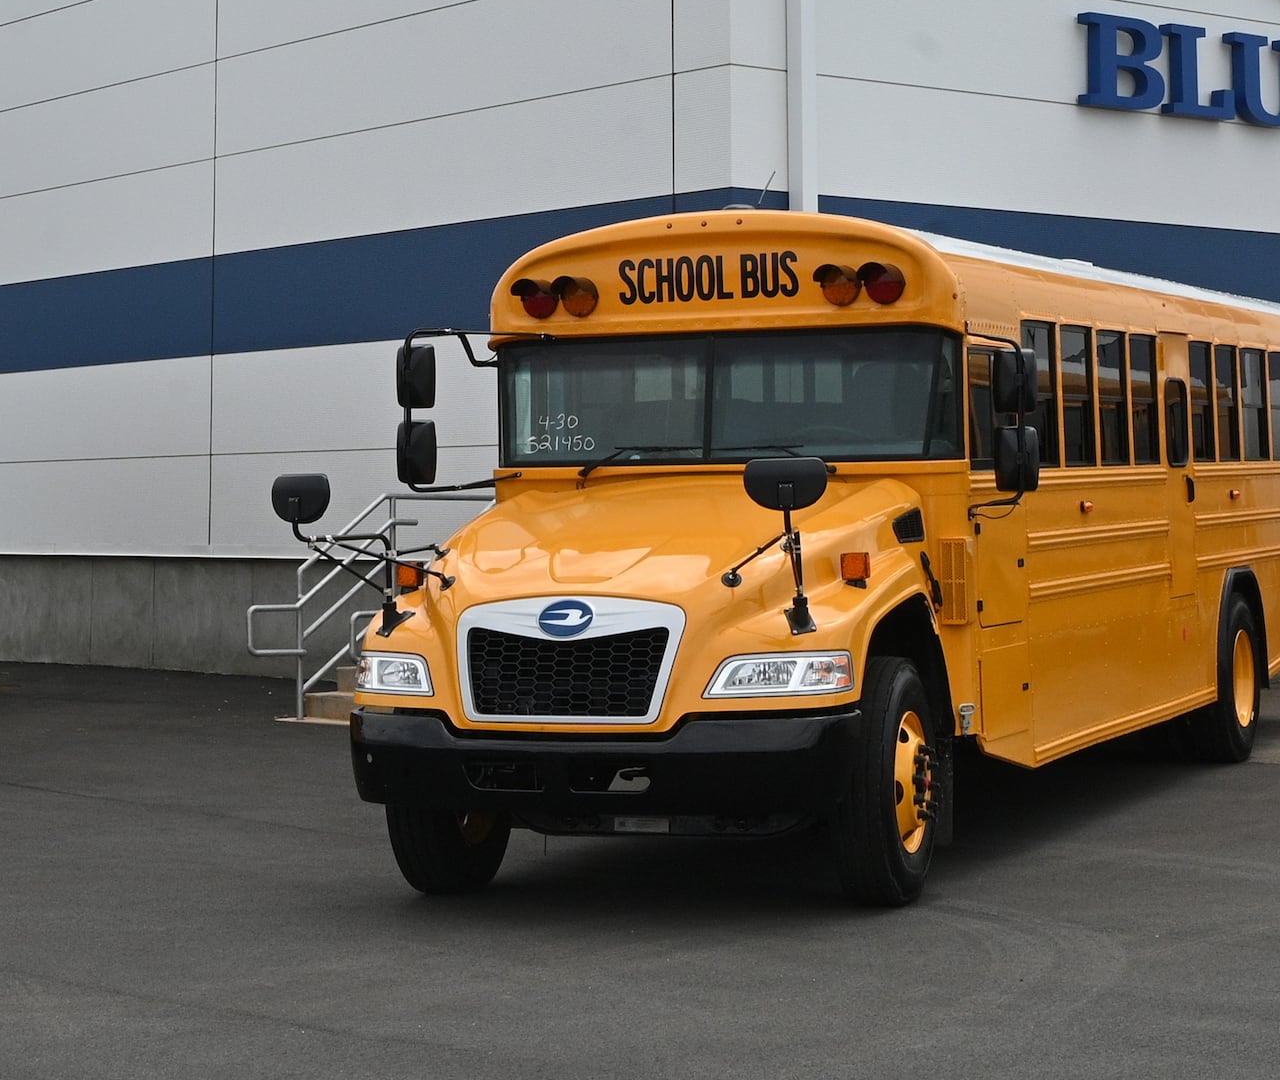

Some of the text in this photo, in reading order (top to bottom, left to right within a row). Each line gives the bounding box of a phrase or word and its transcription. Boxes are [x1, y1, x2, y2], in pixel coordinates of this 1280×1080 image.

[618, 250, 800, 306] SCHOOL BUS
[538, 413, 579, 430] 4-30
[523, 434, 595, 454] 521450
